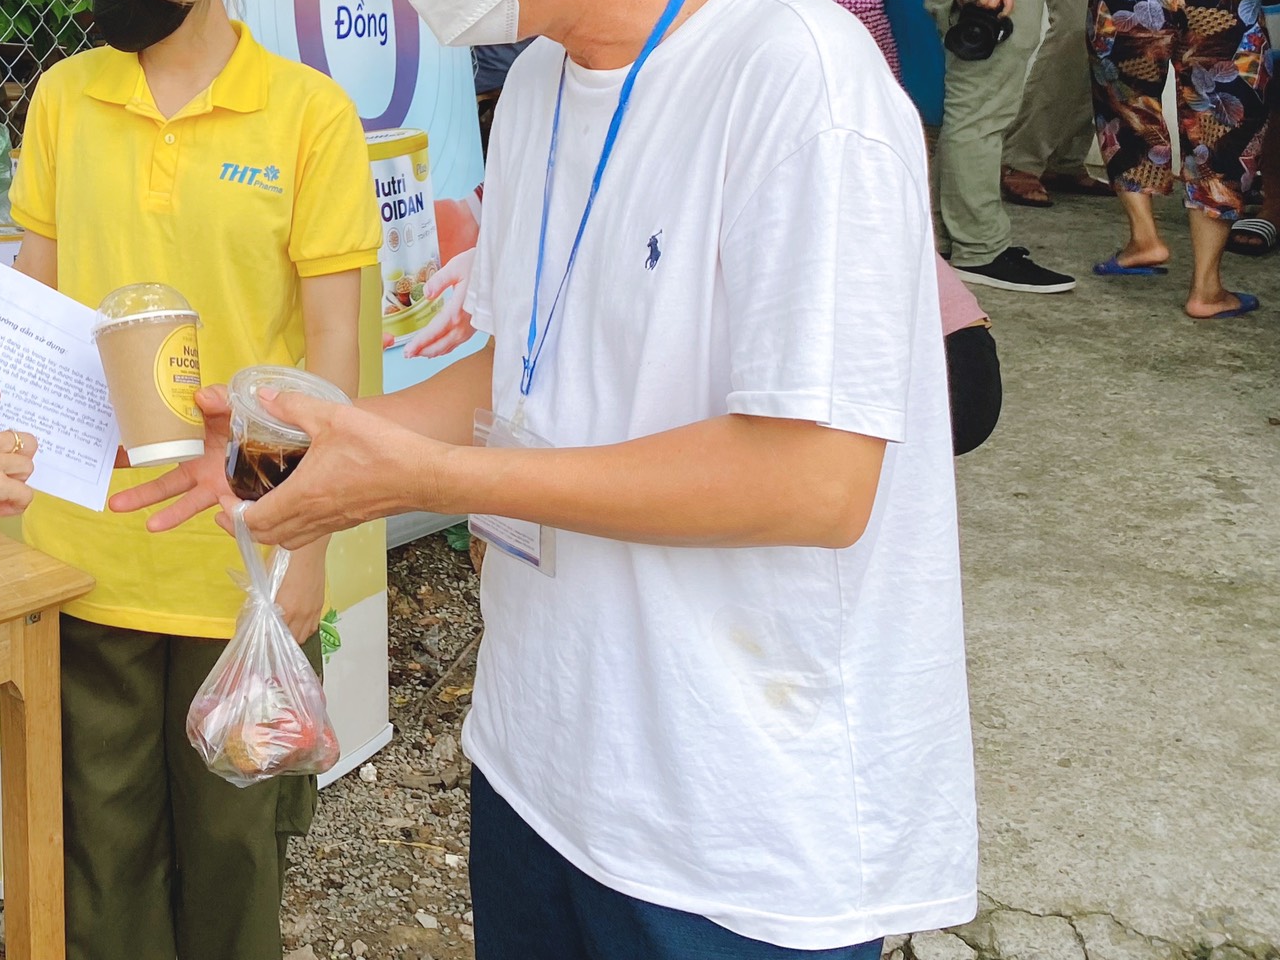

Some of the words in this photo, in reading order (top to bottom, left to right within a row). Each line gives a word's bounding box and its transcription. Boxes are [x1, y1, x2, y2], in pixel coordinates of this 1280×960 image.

[220, 163, 262, 185] THT
[254, 180, 283, 194] Pharma
[19, 327, 33, 337] dẫn
